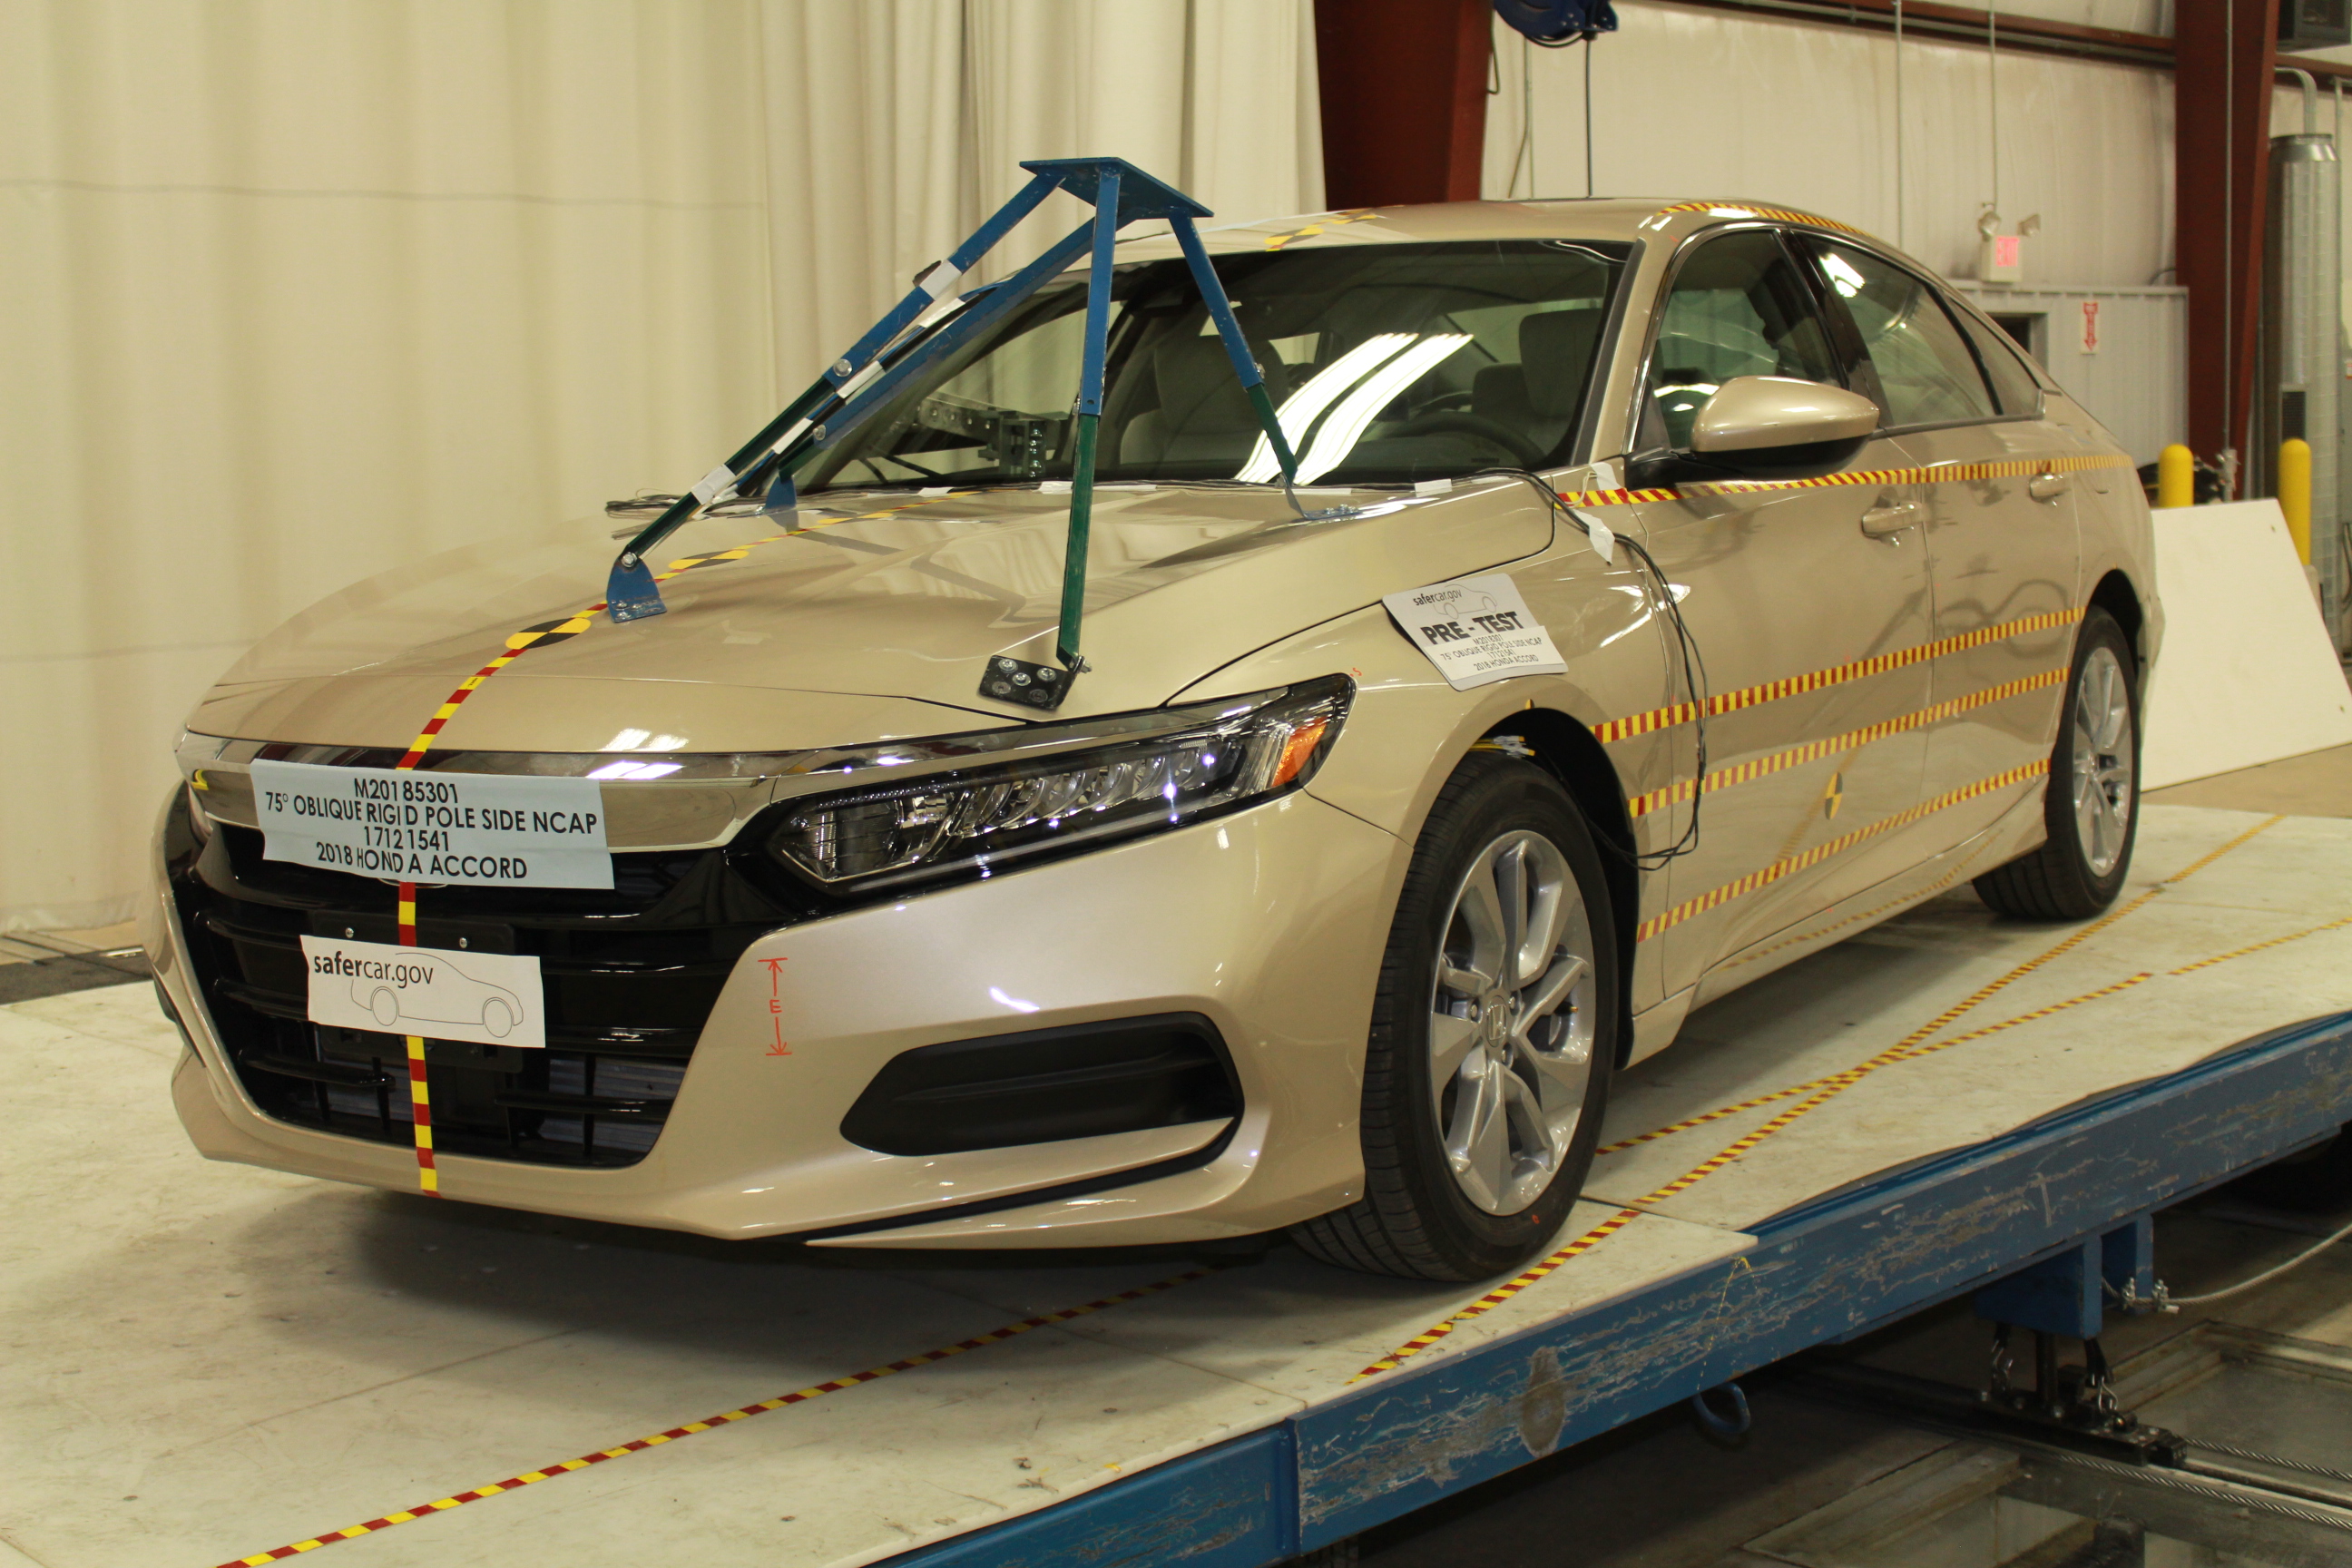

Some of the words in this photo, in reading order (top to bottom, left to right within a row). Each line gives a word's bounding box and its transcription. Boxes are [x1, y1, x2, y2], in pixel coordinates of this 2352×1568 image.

[1413, 589, 1462, 606] safercar.gov
[1420, 621, 1471, 645] PRE
[1472, 611, 1524, 633] TEST
[1452, 646, 1483, 658] OBLIQUE
[1480, 642, 1500, 652] RIGID
[1497, 641, 1515, 650] POLE
[1513, 639, 1527, 648] SIDE
[1524, 636, 1543, 647] NCAP
[1473, 662, 1492, 671] 2018
[1489, 657, 1514, 668] HONDA
[1514, 654, 1539, 663] ACCORD
[354, 778, 458, 803] M20185301
[293, 795, 362, 820] OBLIQUE
[367, 802, 418, 826] RIGID
[426, 806, 475, 828] POLE
[482, 808, 526, 832] SIDE
[533, 811, 597, 834] NCAP
[364, 826, 449, 851] 17121541
[317, 841, 353, 866] 2018
[357, 847, 423, 874] HONDA
[430, 855, 528, 878] ACCORD
[314, 950, 434, 989] safercar.gov
[769, 999, 782, 1014] E
